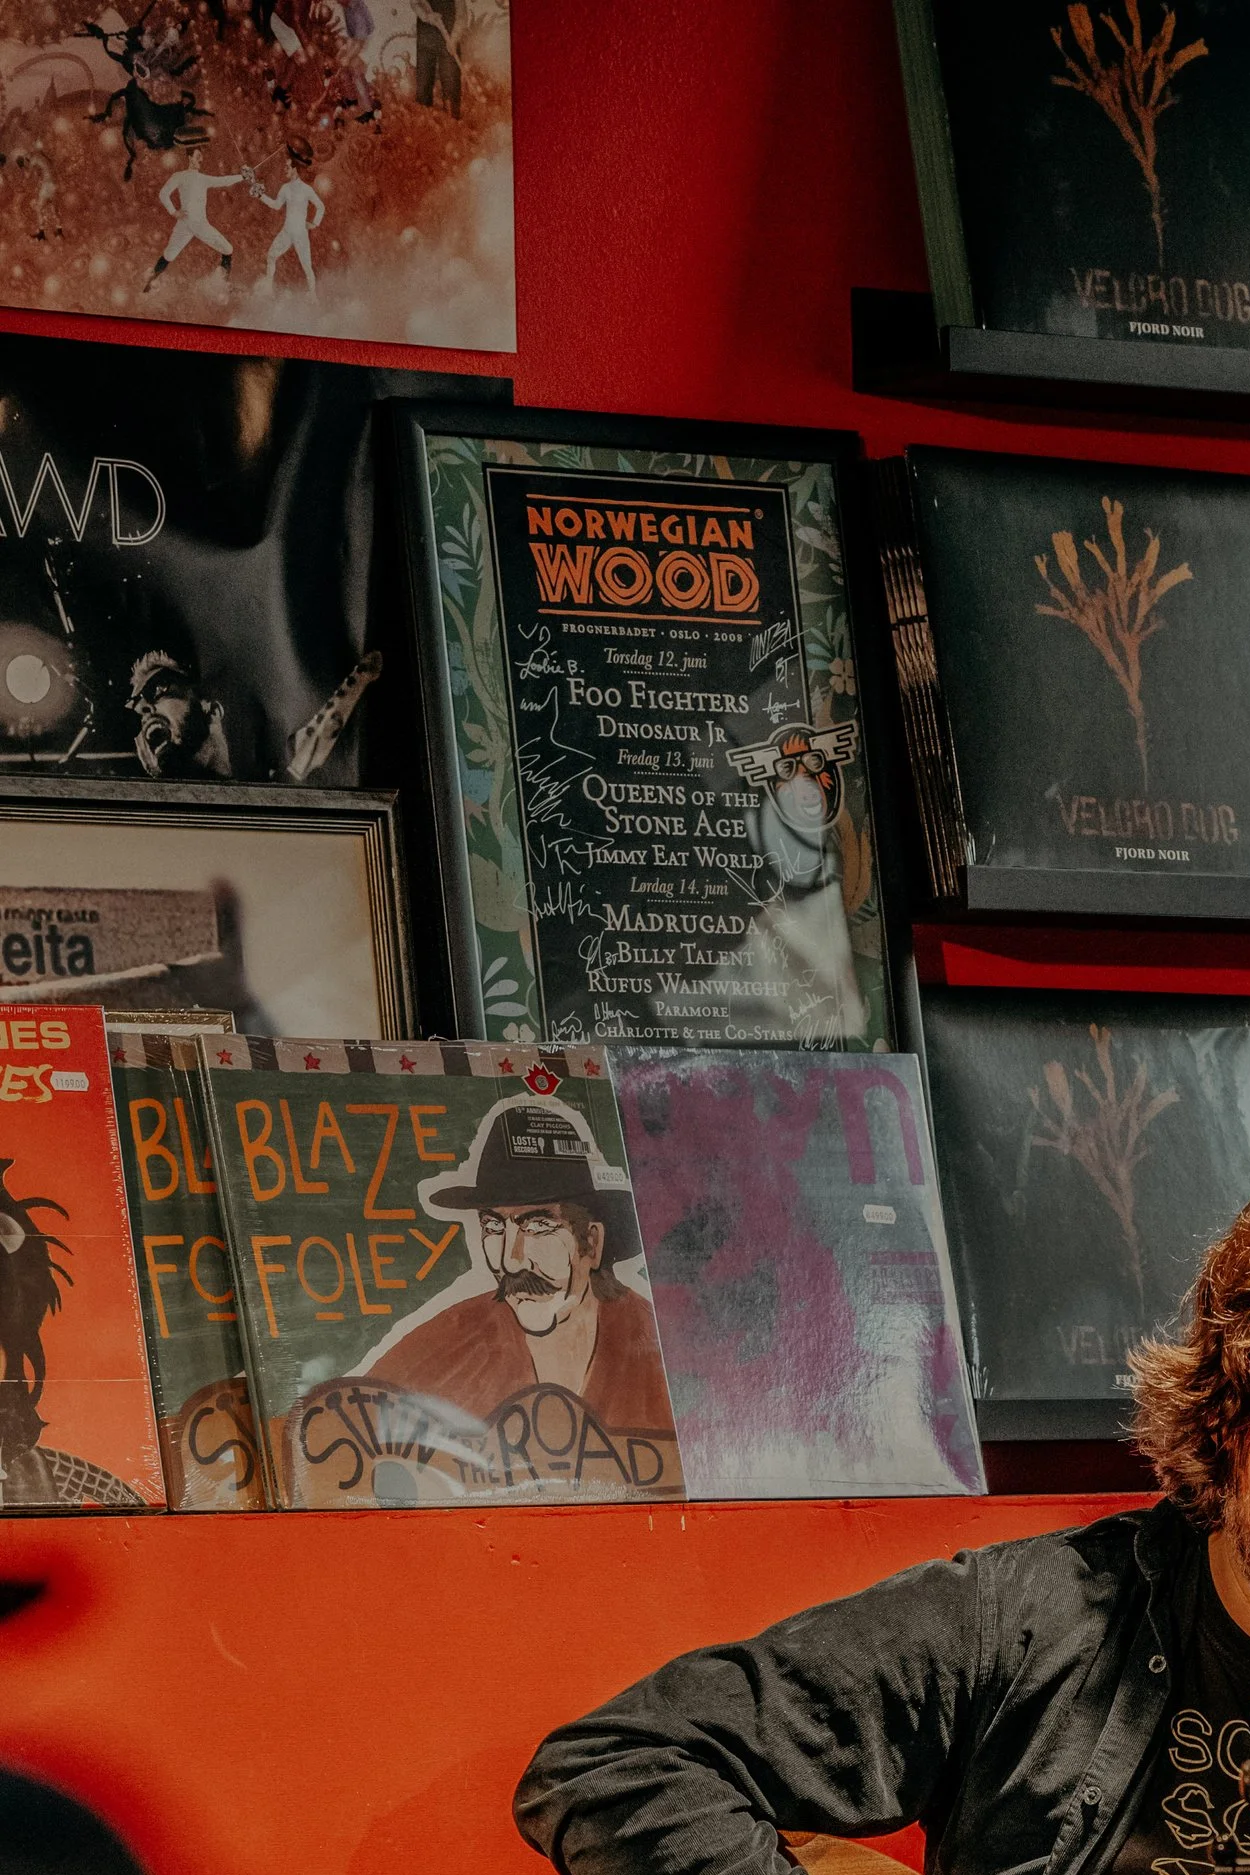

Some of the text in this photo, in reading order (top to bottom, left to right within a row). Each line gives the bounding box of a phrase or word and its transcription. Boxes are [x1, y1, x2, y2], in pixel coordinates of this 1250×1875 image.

[1129, 321, 1204, 338] FJORD NOIR
[527, 505, 755, 549] NORWEGIAN
[528, 542, 760, 613] WOOD
[562, 623, 743, 643] FROGNERBADET OSLO 2008
[604, 648, 707, 670] Torsdag 12. juni
[617, 748, 714, 771] Fredag 13. juni
[1115, 847, 1190, 862] FJORD NOIR
[630, 875, 729, 898] Lørdag 14. juni
[682, 1026, 694, 1040] &
[129, 1097, 217, 1201] BL
[512, 1136, 533, 1146] LOST
[236, 1099, 456, 1220] BLAZE
[251, 1224, 460, 1338] FOLEY
[497, 1390, 664, 1492] ROAD
